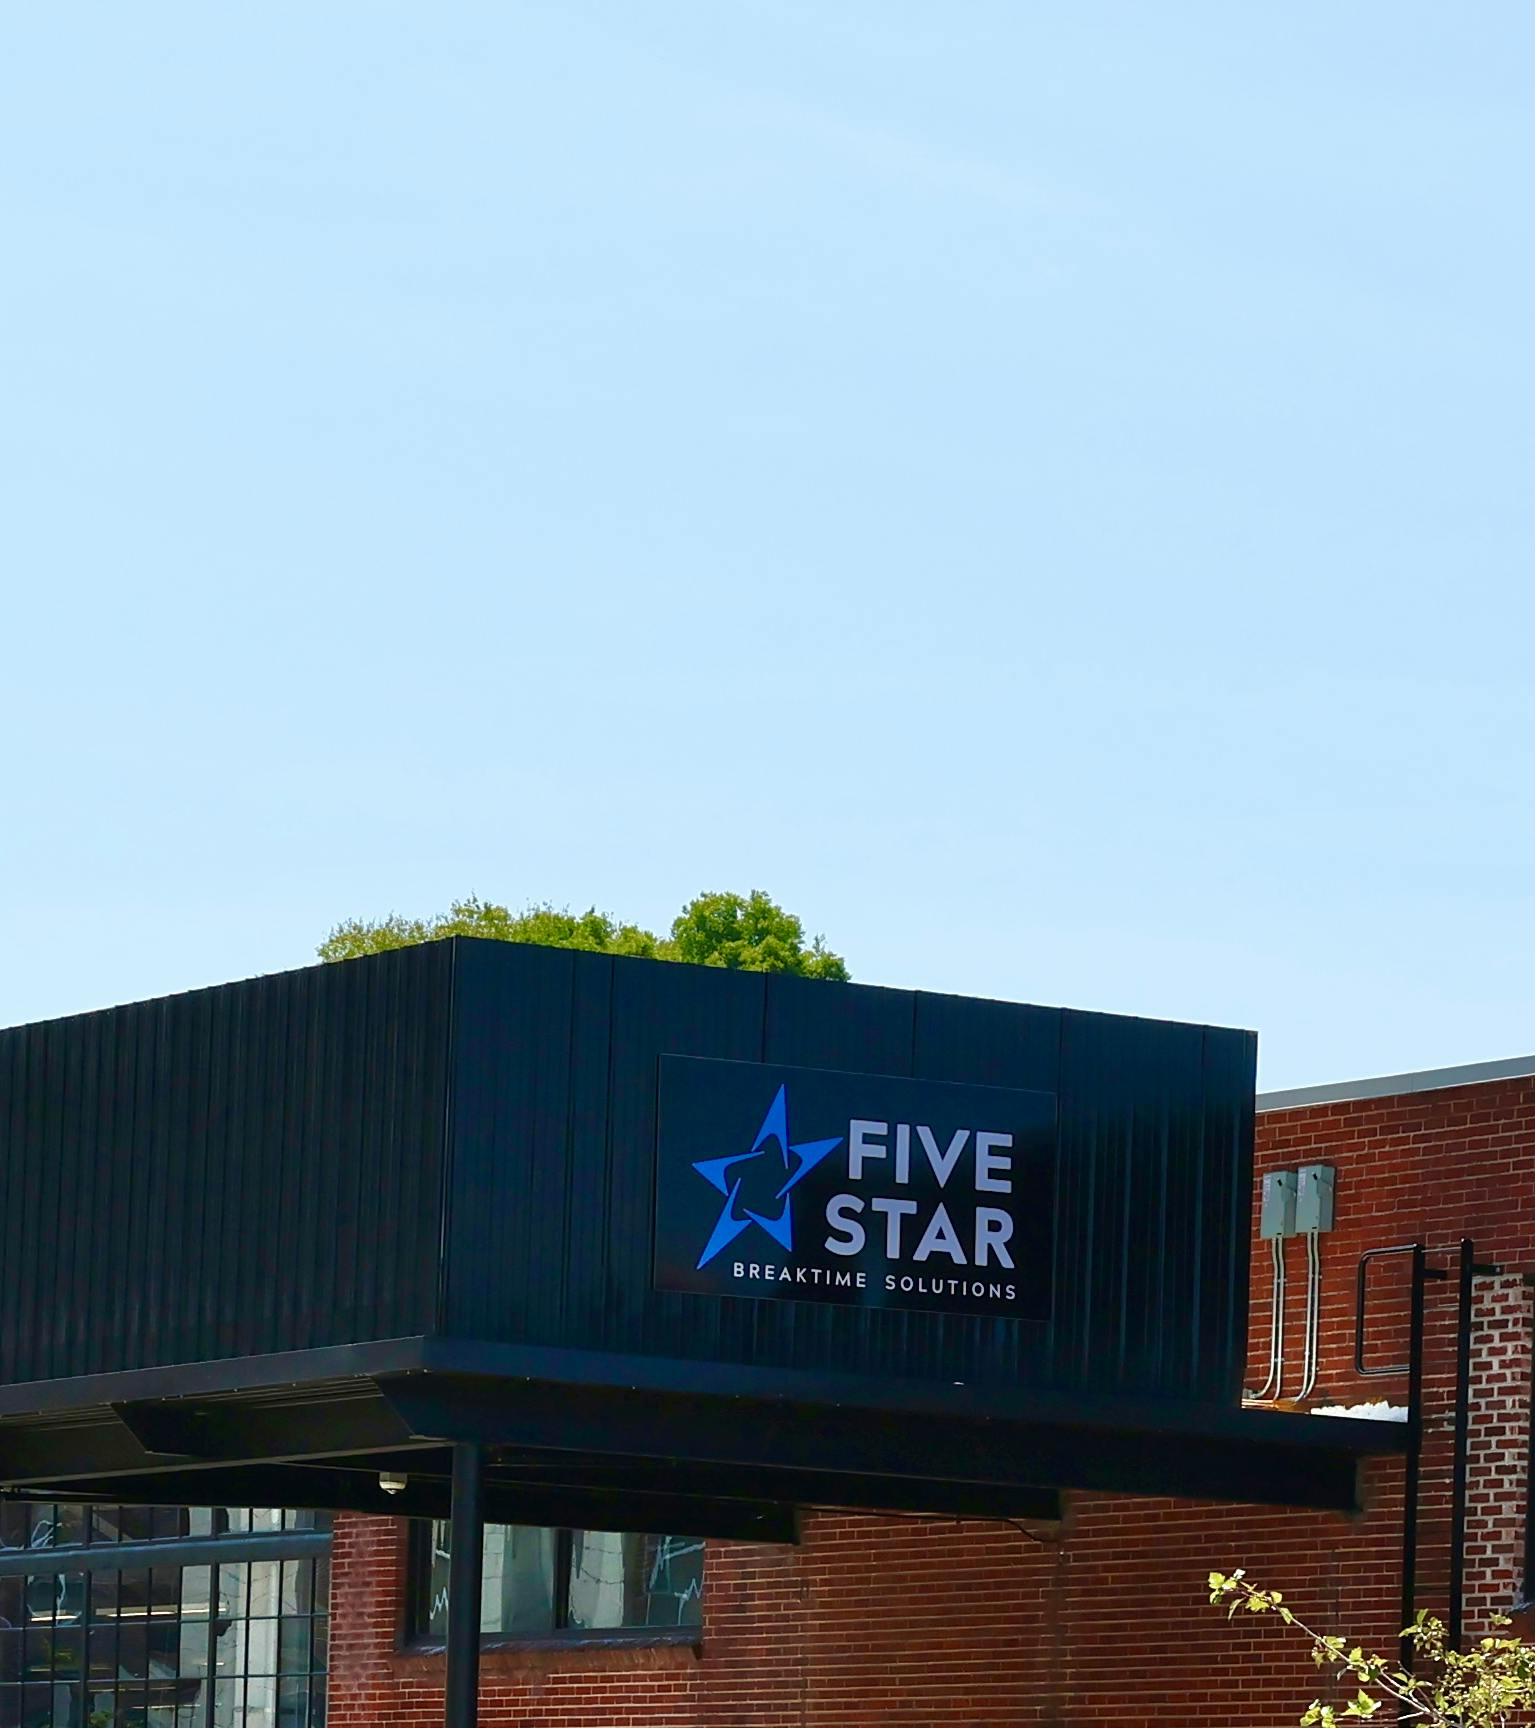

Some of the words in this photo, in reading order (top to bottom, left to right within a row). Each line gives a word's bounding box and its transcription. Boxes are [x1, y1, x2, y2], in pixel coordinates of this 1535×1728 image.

[848, 1119, 1013, 1194] FIVE
[824, 1193, 1015, 1269] STAR
[733, 1262, 868, 1288] BREAKTIME
[885, 1275, 1016, 1300] SOLUTIONS
